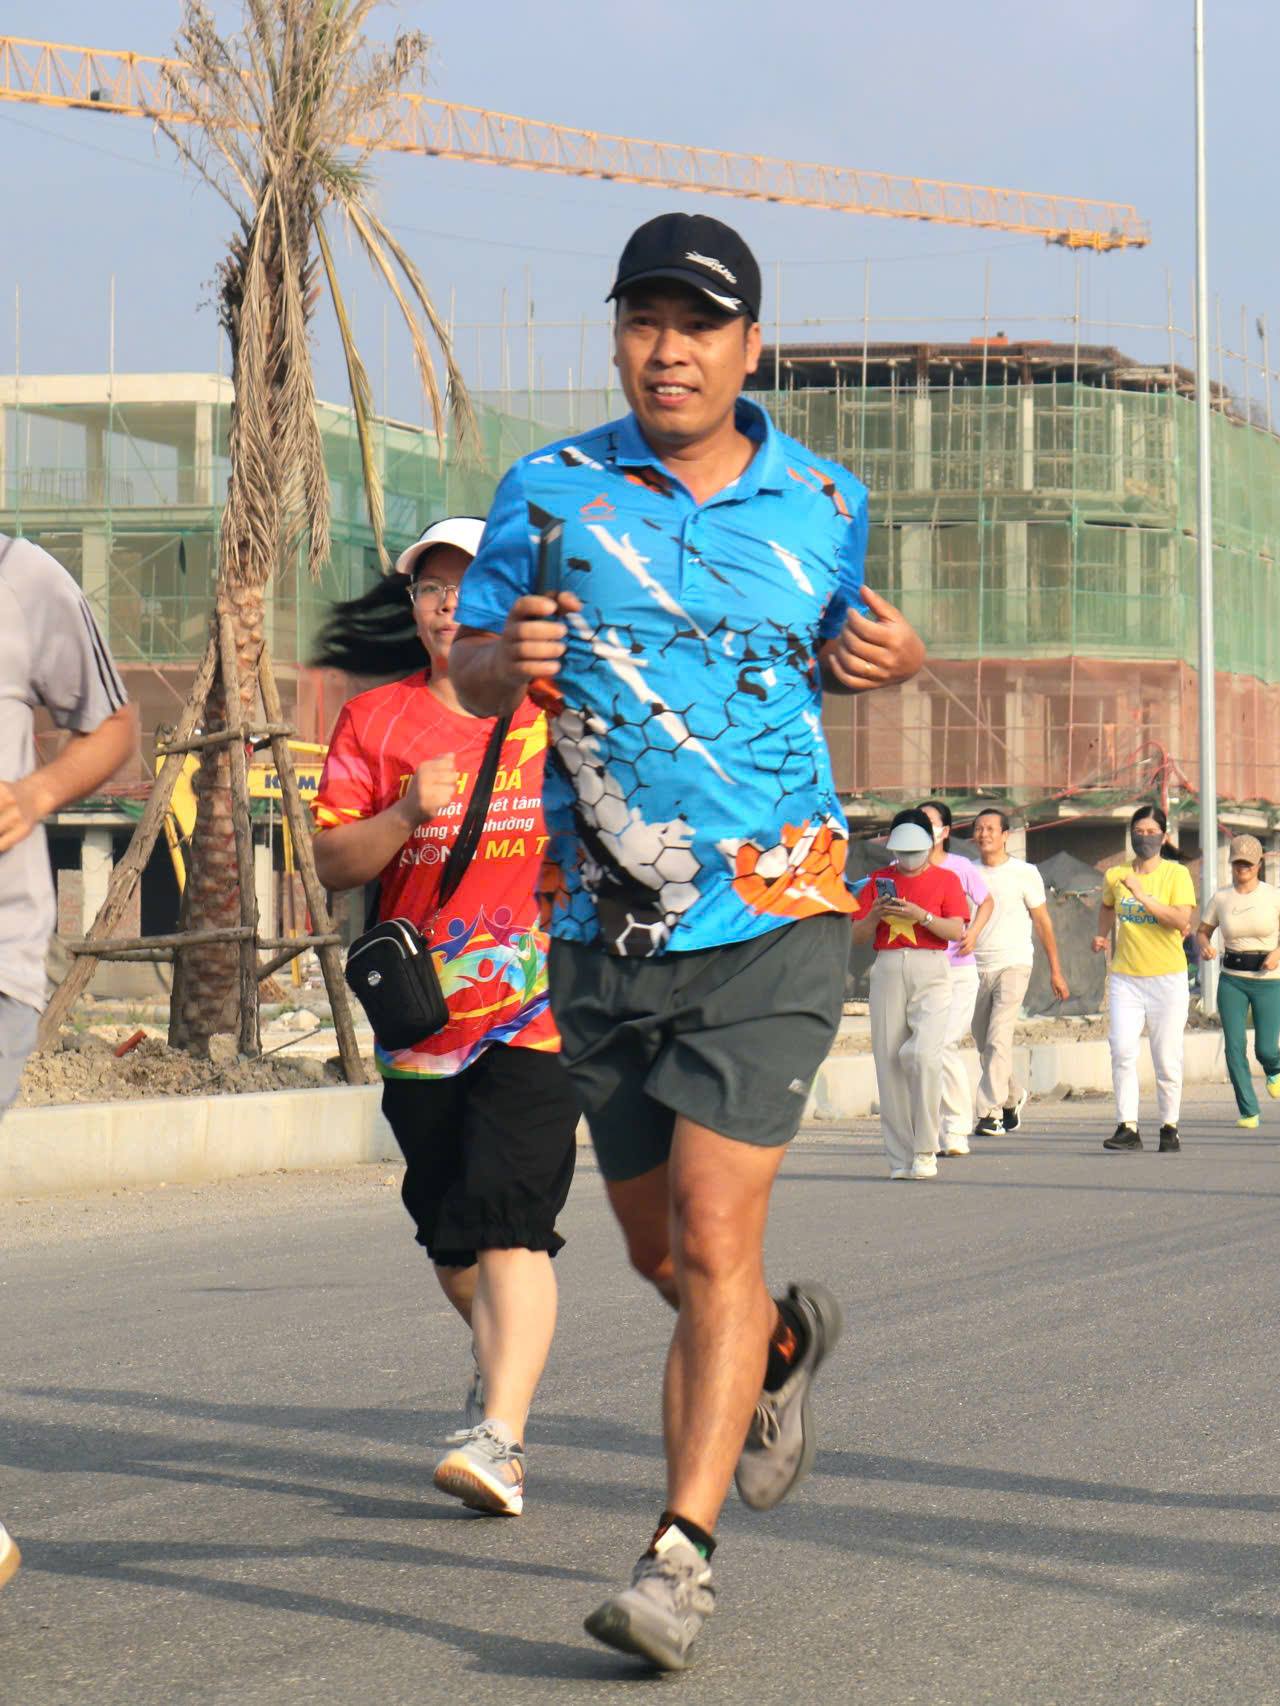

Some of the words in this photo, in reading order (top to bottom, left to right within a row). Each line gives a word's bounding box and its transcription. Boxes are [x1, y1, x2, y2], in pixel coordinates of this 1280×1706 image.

[492, 764, 522, 793] ÓA
[512, 795, 542, 811] tâm
[413, 823, 449, 842] dựng
[484, 837, 526, 860] MA
